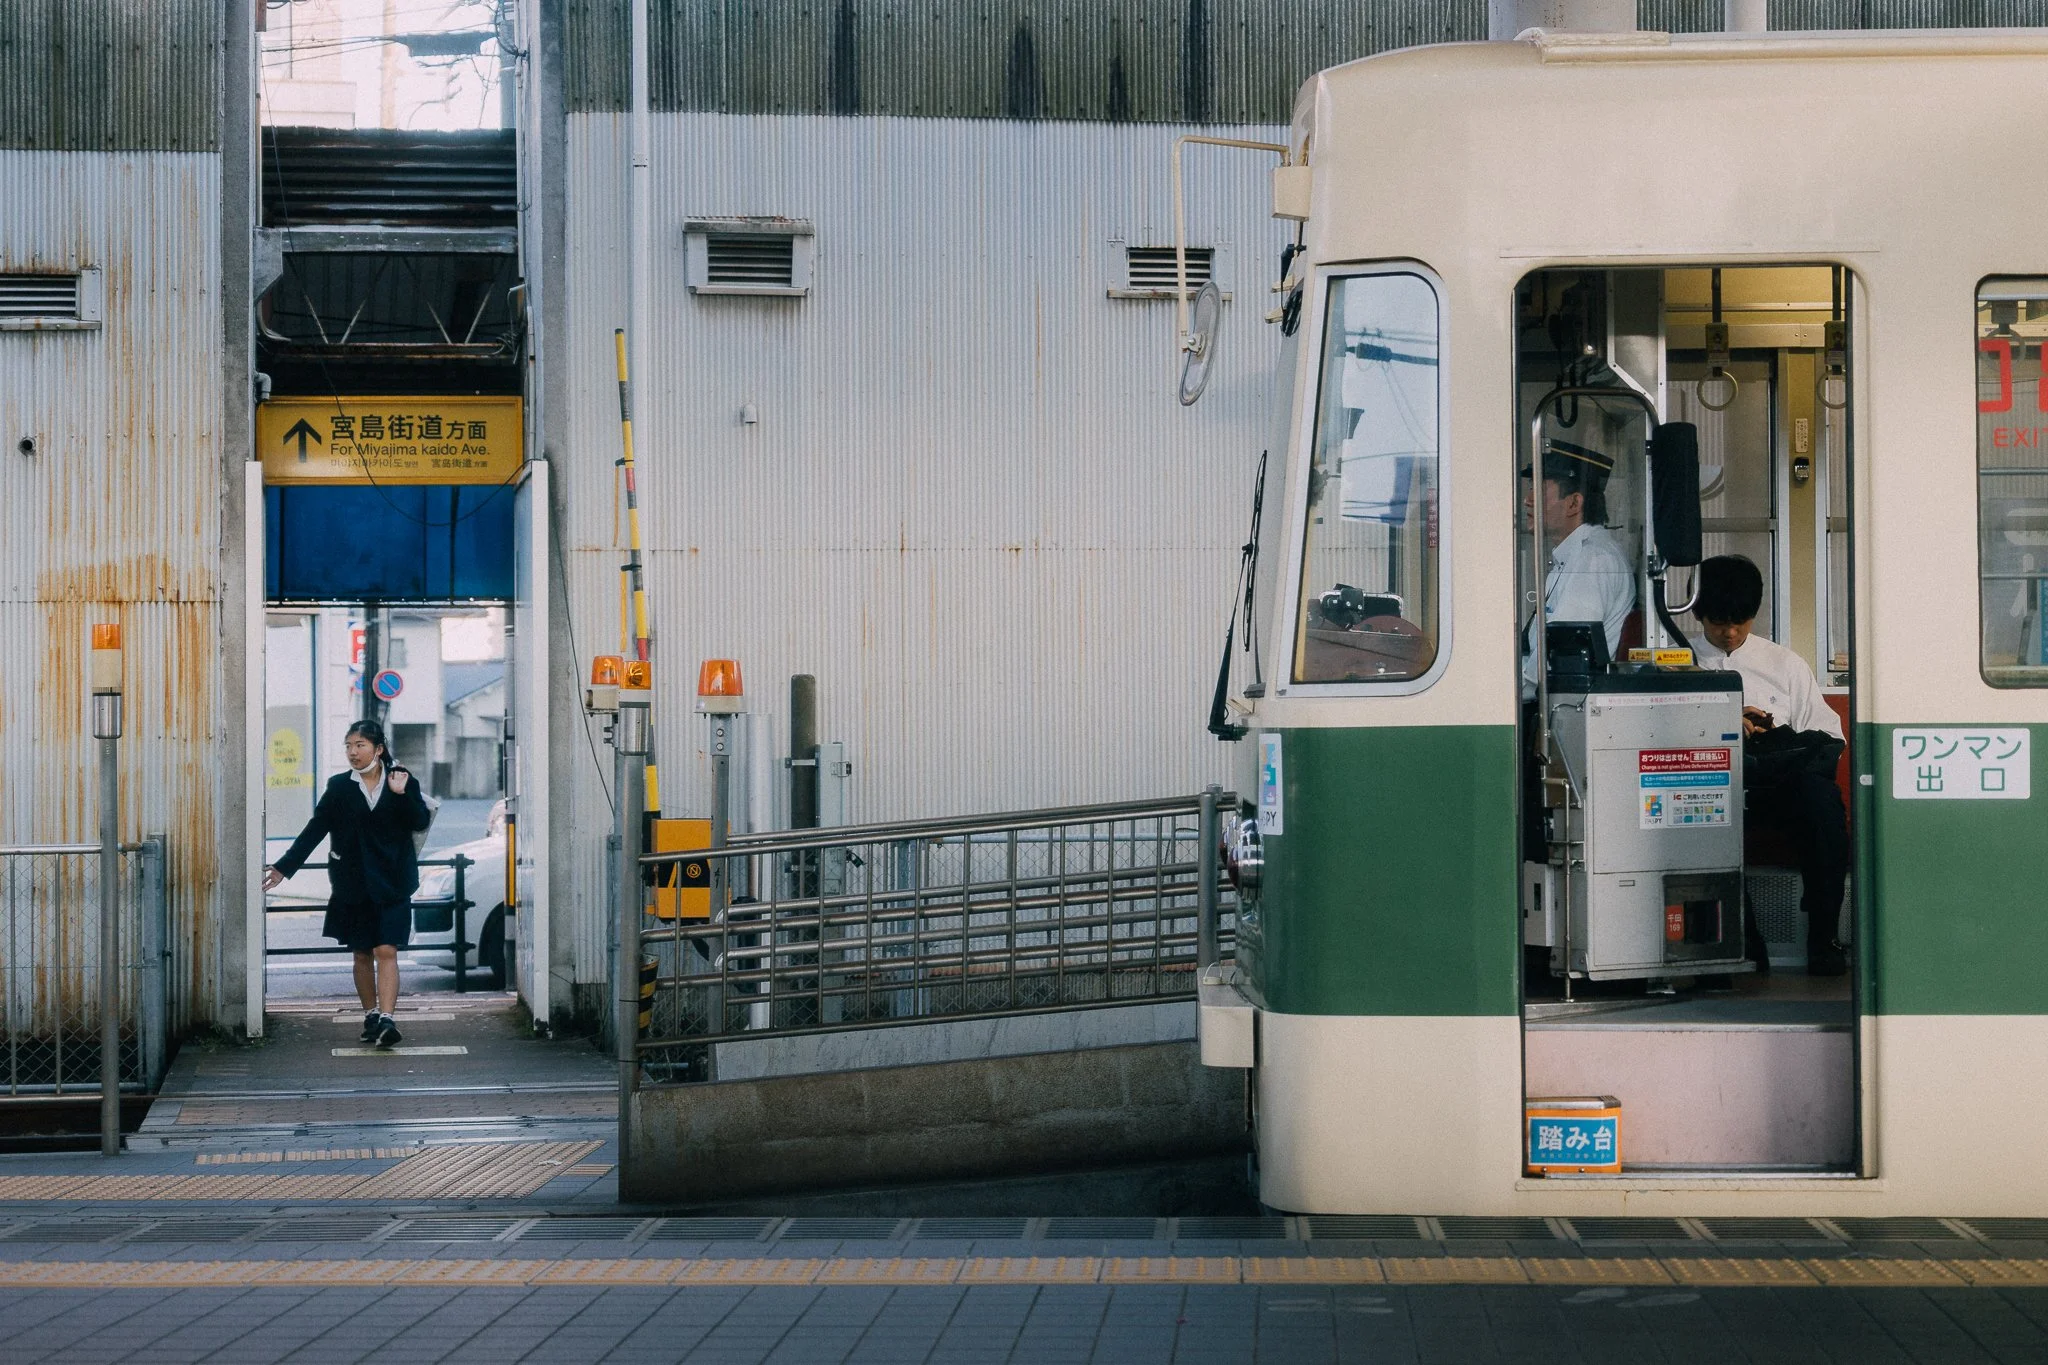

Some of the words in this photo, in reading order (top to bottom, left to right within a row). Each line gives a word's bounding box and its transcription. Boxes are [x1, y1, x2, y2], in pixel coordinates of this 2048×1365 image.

[330, 414, 487, 440] 宮島街道方面
[330, 443, 353, 455] For
[357, 443, 417, 458] Miyajima
[421, 443, 458, 455] kaido
[461, 443, 490, 455] Ave.
[1641, 753, 1690, 762] おつりは出ません
[1902, 735, 2022, 760] ワンマン
[1917, 765, 2005, 792] 出口
[1670, 923, 1681, 932] 169
[1538, 1125, 1612, 1151] 踏み台
